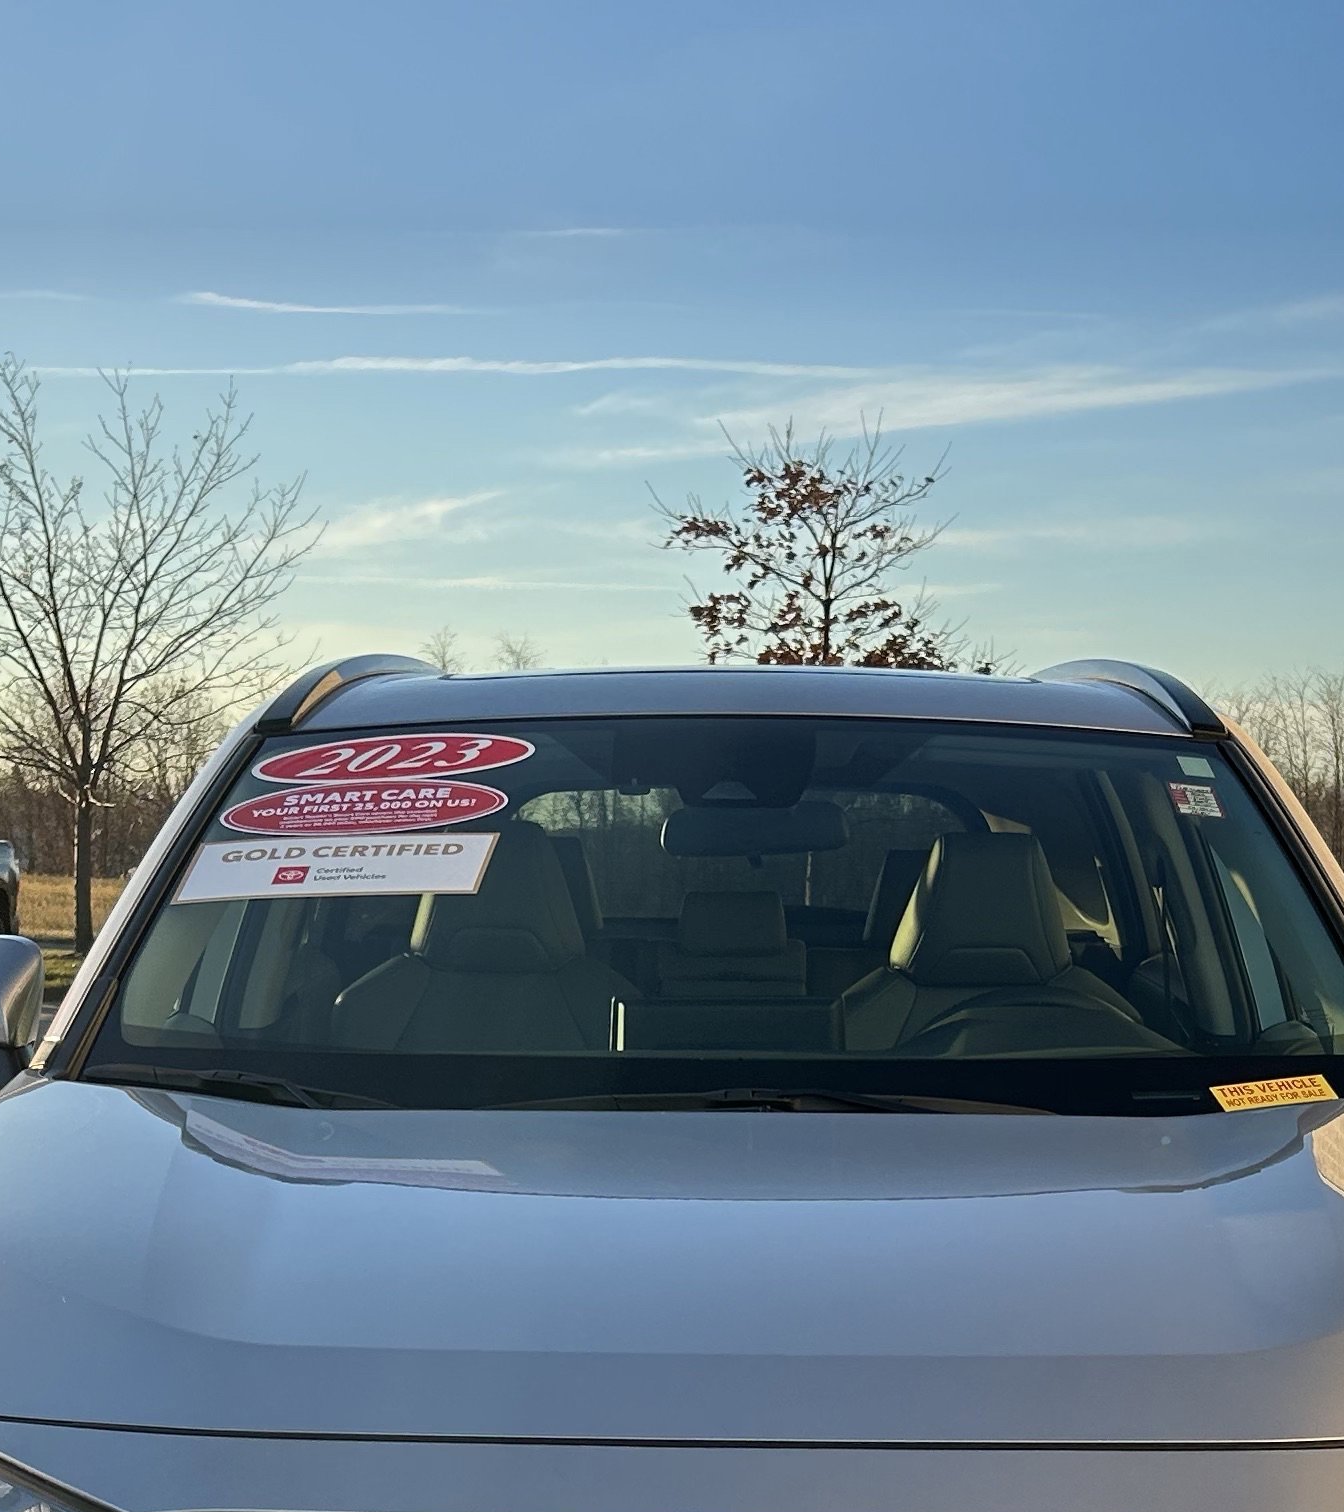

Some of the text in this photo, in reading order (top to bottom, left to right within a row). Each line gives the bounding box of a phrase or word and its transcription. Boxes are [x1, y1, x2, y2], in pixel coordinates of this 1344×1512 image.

[294, 739, 493, 777] 2023
[283, 787, 452, 806] SMART CARE
[252, 806, 300, 818] YOUR
[302, 803, 350, 815] FIRST
[352, 800, 413, 812] 25,000
[414, 799, 444, 809] ON
[446, 798, 477, 808] US!
[221, 843, 464, 863] GOLD CERTIFIED
[313, 873, 388, 882] Used Vehicles
[316, 866, 364, 874] Certified
[1218, 1078, 1321, 1098] THIS VEHICLE
[1225, 1089, 1326, 1108] NOT READY FOR SALE
